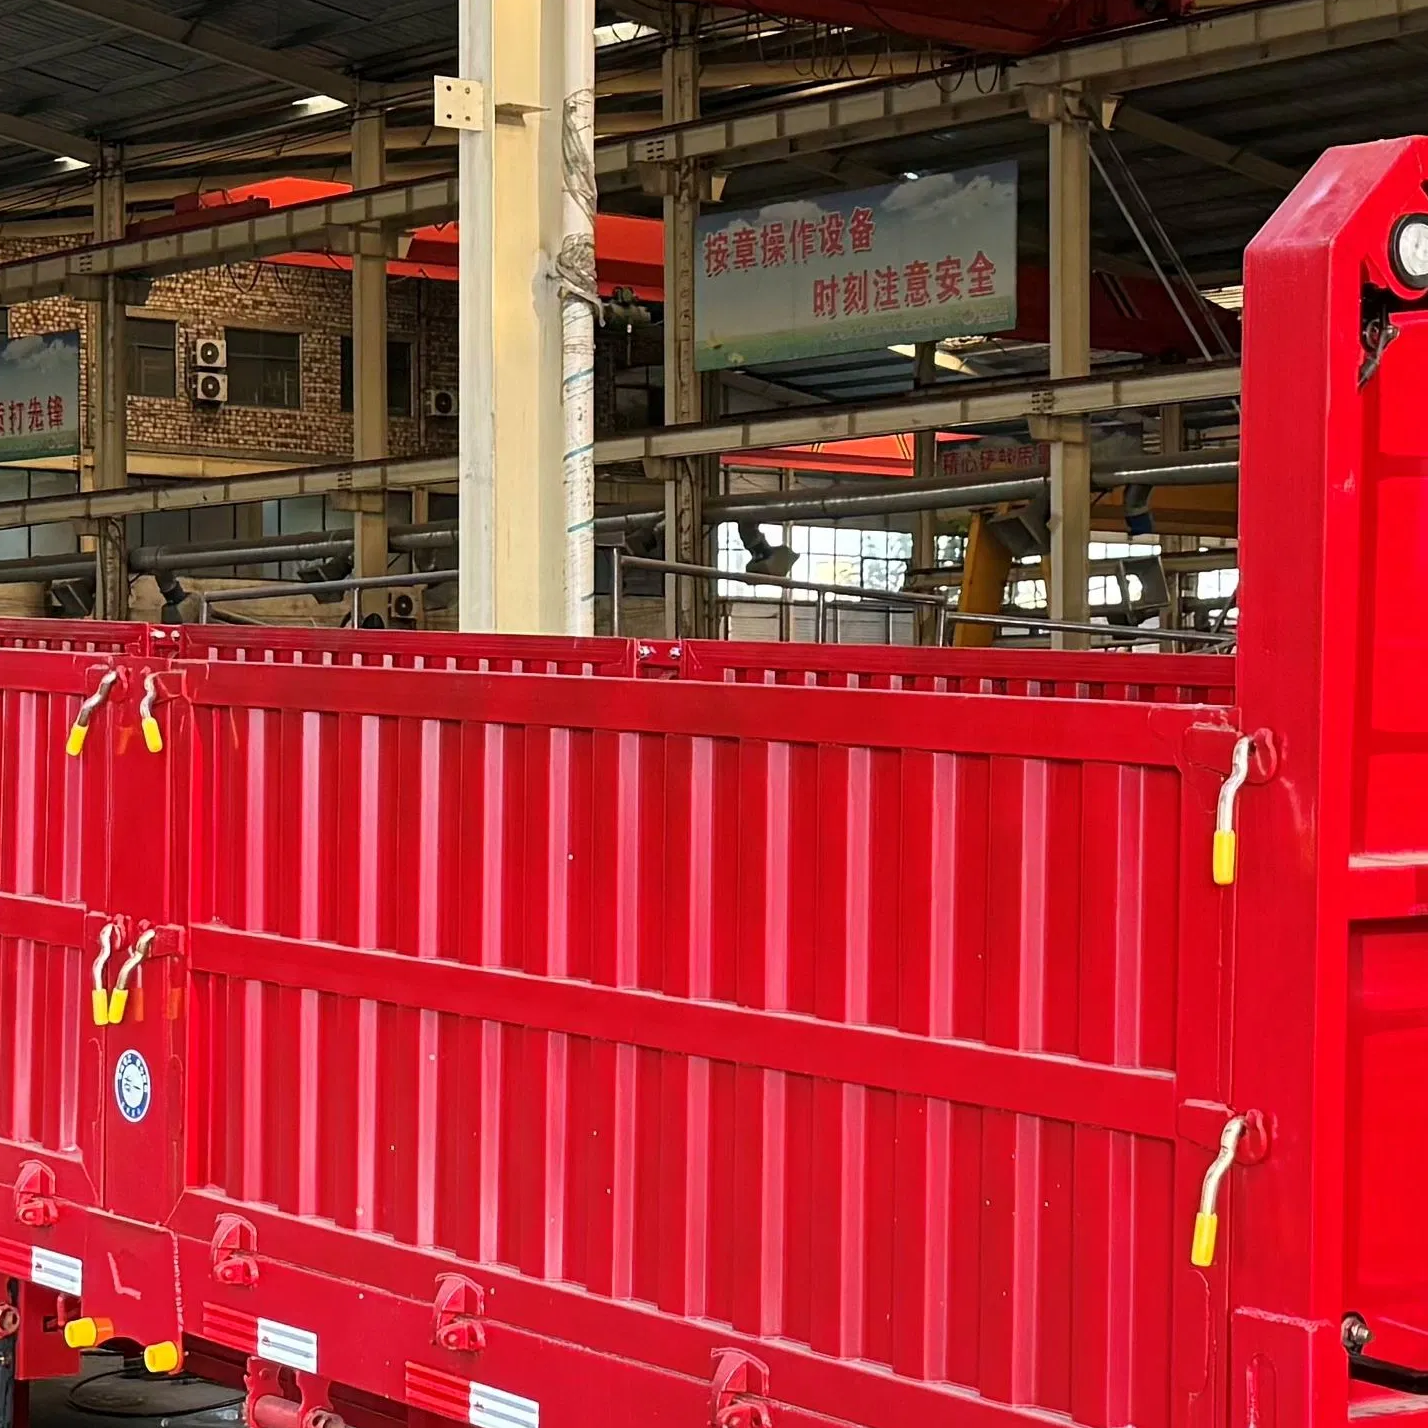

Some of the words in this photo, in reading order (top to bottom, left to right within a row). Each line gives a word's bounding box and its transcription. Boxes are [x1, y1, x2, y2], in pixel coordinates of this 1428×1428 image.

[704, 206, 875, 278] 按章操作设备
[813, 250, 996, 318] 时刻注意安全
